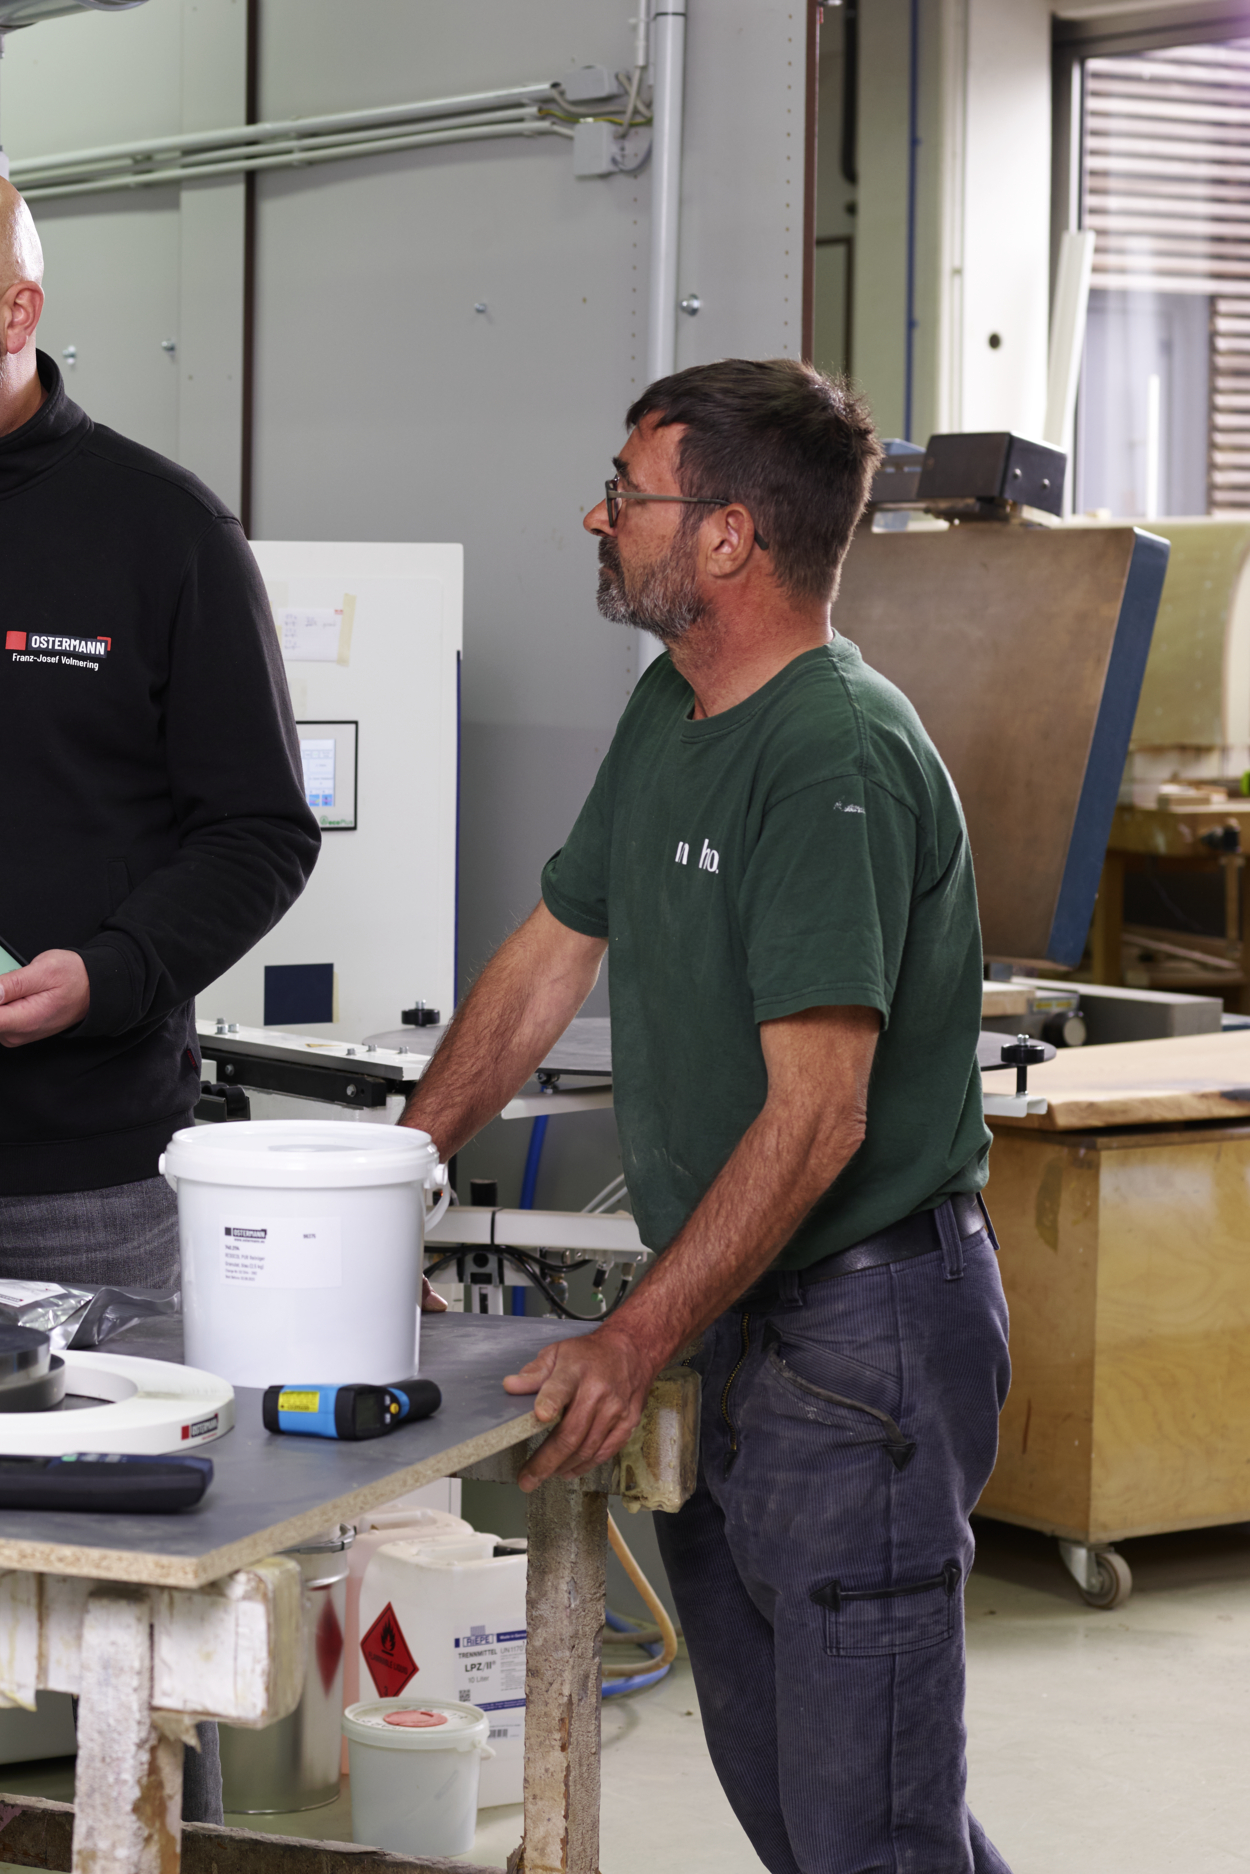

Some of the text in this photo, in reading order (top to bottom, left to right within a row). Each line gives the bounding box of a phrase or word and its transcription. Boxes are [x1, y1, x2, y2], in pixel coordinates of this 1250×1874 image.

[31, 635, 105, 655] OSTERMANN
[12, 653, 99, 671] Franz-Josef Volmering
[233, 1229, 266, 1239] OSTERMANN
[458, 1649, 497, 1659] TRENNMITTEL
[476, 1675, 489, 1683] Liter
